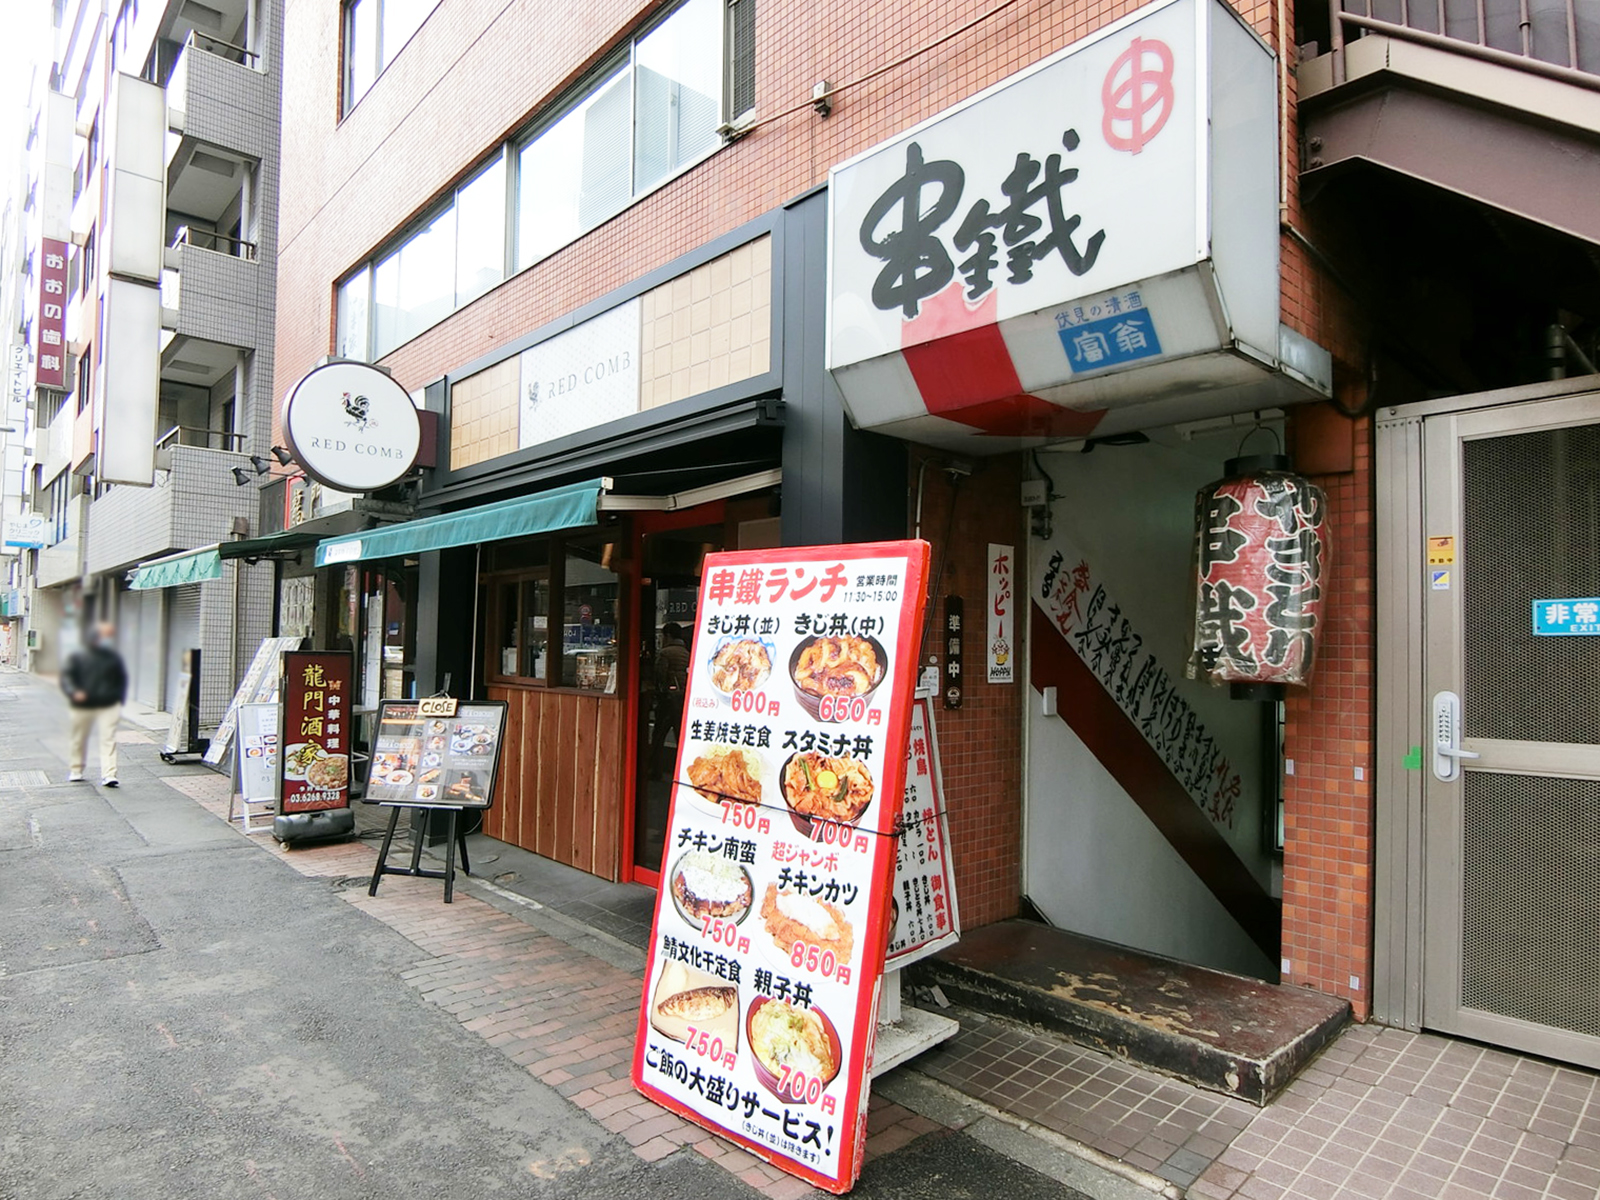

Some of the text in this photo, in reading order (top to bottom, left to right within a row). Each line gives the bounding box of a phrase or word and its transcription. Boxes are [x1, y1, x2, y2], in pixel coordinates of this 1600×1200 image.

[41, 253, 65, 372] おおの歯科
[1054, 291, 1143, 329] 伏見の清酒
[12, 346, 24, 403] クリエイトビル
[548, 351, 631, 399] RED COMB
[311, 436, 404, 460] RED COMB
[708, 563, 848, 606] 串鐵ランチ
[856, 575, 898, 588] 営業時間
[992, 549, 1011, 639] ホッピー
[948, 614, 960, 678] 準備中
[300, 664, 327, 766] 龍門酒家
[327, 695, 341, 750] 中華料理
[421, 700, 454, 713] CLOSE
[731, 689, 781, 717] 600円
[819, 695, 882, 726] 650円
[690, 719, 772, 748] 生姜焼き定食
[782, 729, 874, 761] スタミナ丼
[721, 802, 771, 836] 750円
[810, 817, 869, 854] 700円
[677, 827, 758, 865] チキン南蛮
[771, 840, 840, 873] 超ジャンボ
[777, 866, 859, 907] チキンカツ
[930, 874, 946, 930] 御食事
[700, 915, 751, 954] 750円
[789, 941, 852, 986] 850円
[753, 967, 814, 1010] 親子丼
[683, 1026, 737, 1072] 750円
[777, 1064, 837, 1116] 700円
